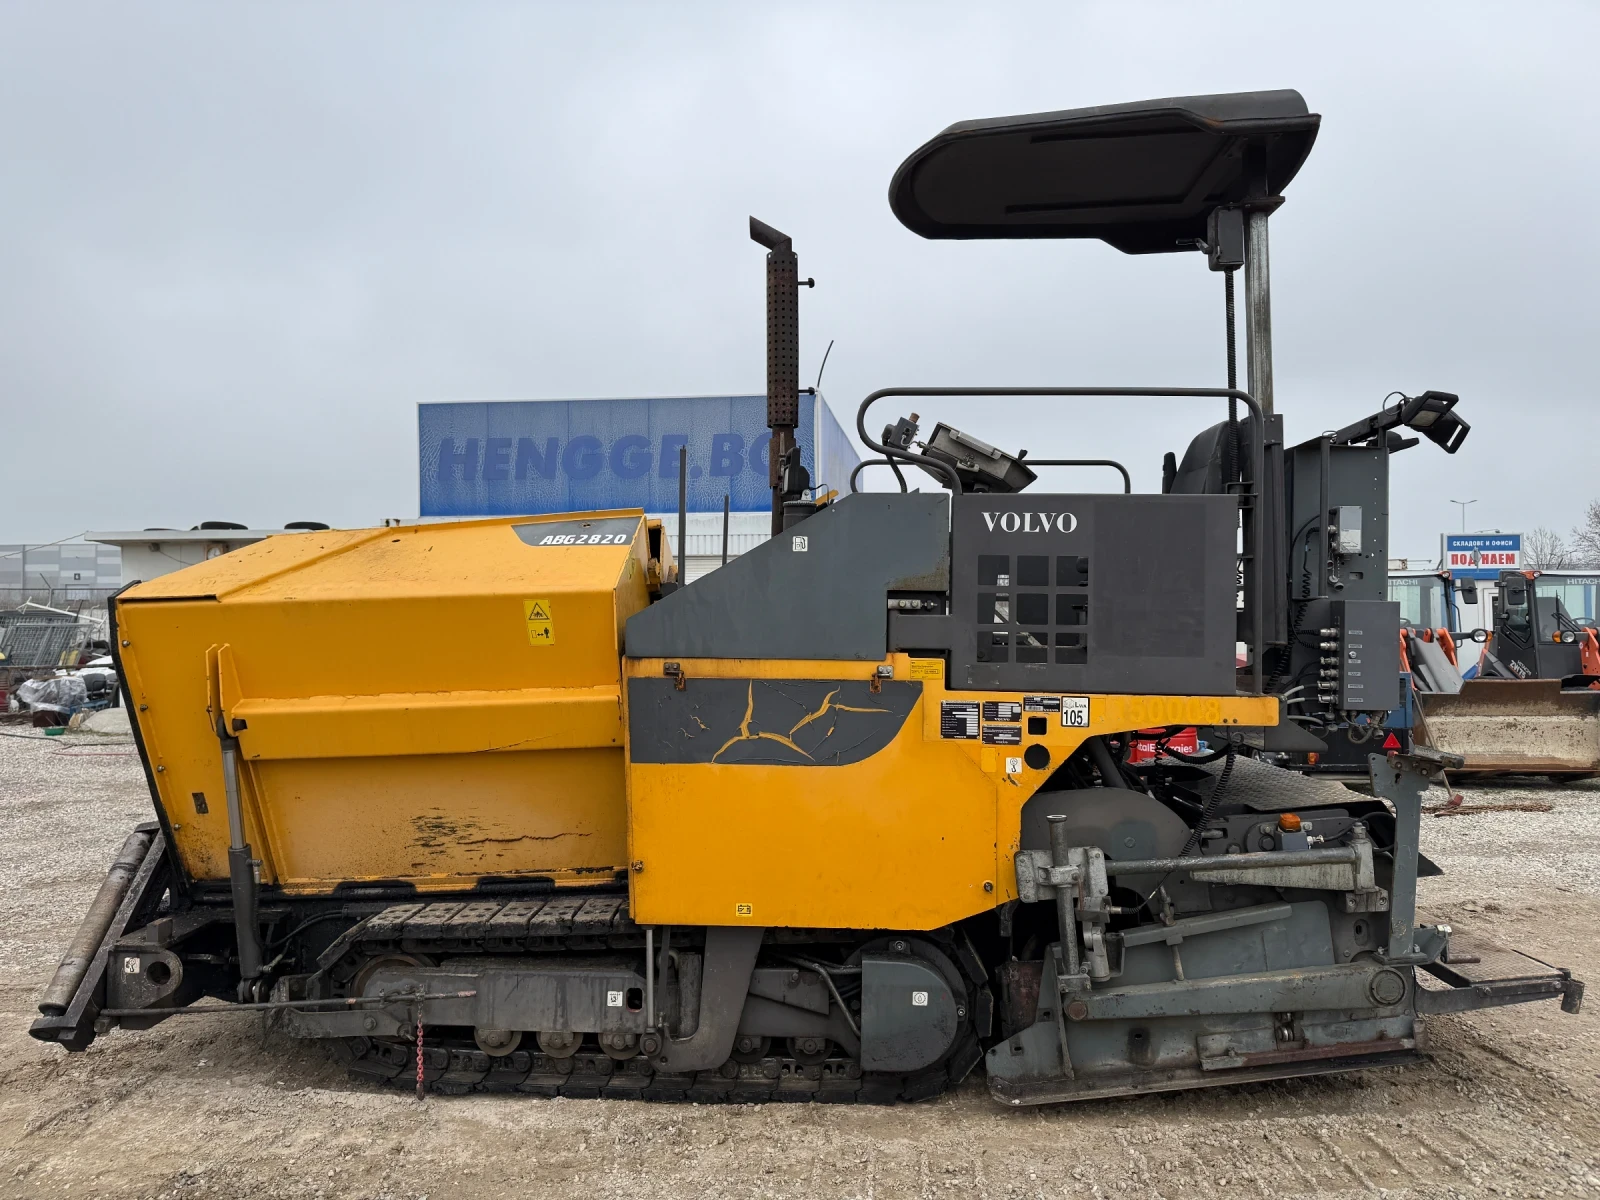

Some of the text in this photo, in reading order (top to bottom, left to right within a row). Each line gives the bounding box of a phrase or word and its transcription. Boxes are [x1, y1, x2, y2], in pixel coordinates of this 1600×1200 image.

[982, 512, 1077, 533] VOLVO
[539, 534, 627, 545] ABG2820
[1451, 553, 1515, 566] ПОД НАЕМ
[1064, 709, 1083, 725] 105
